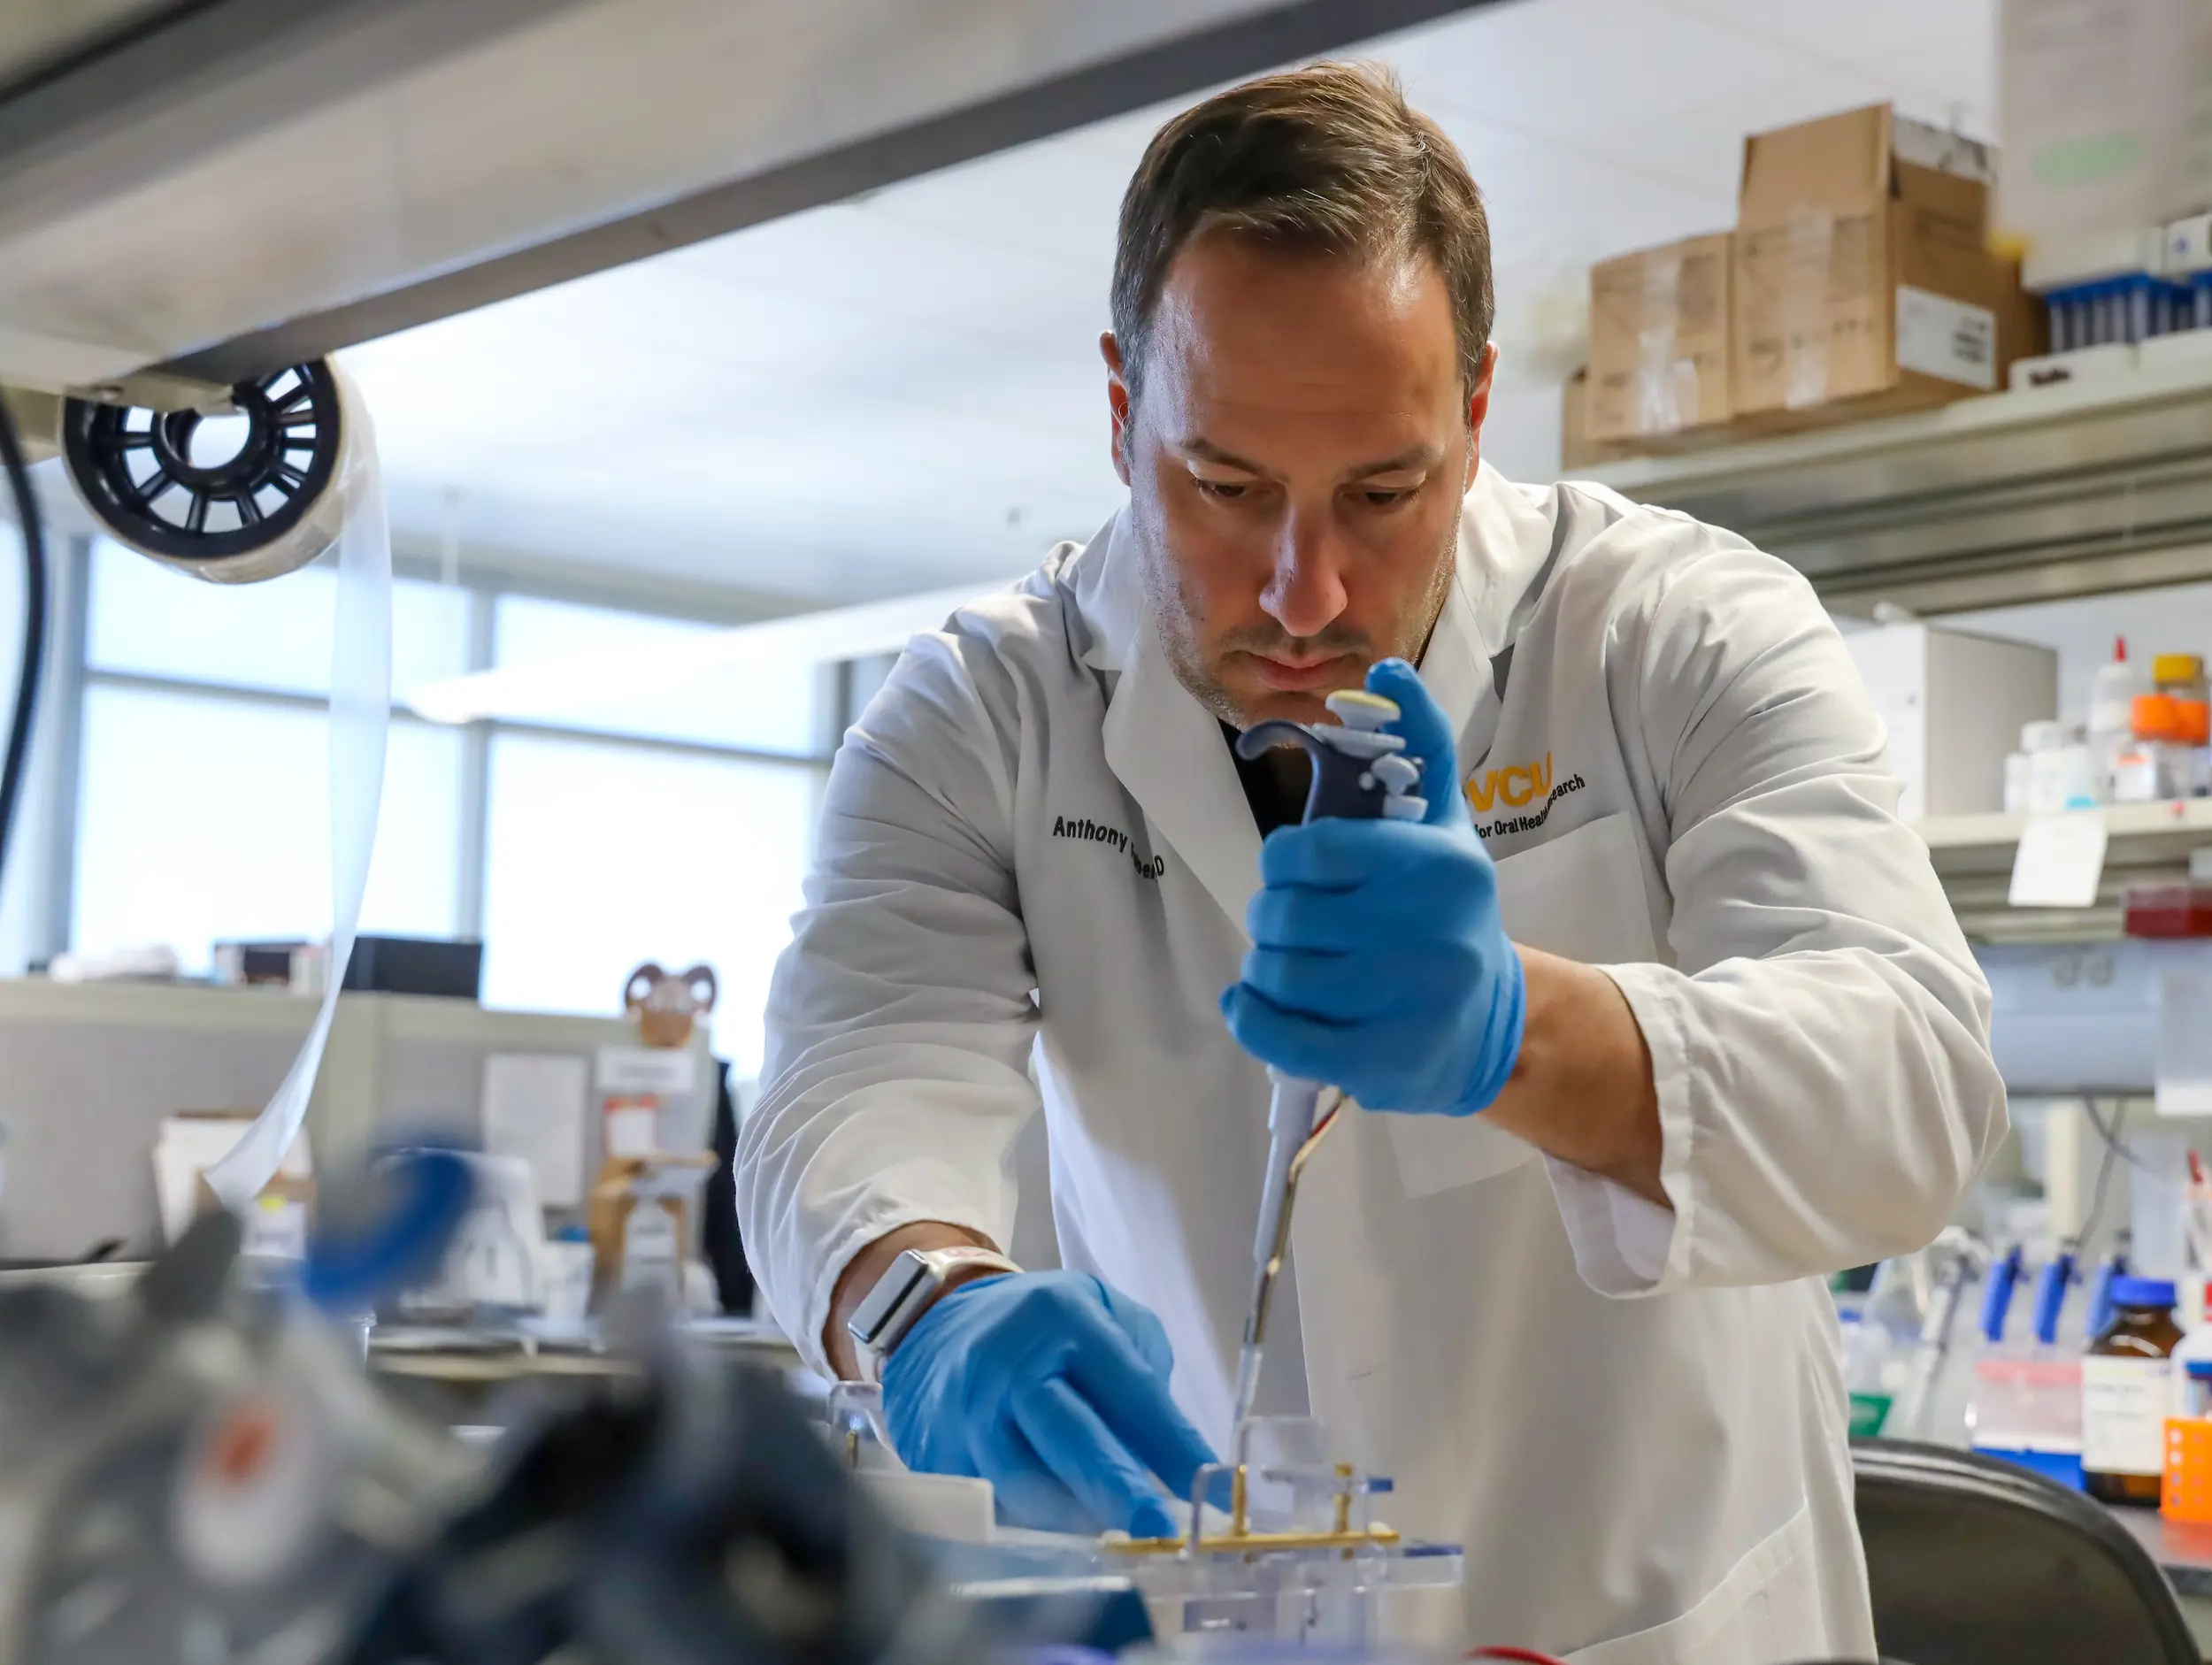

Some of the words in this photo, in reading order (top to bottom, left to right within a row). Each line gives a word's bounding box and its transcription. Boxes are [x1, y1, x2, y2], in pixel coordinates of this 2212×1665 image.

[1467, 749, 1553, 813] VCU
[1053, 816, 1128, 854] Anthony
[1494, 818, 1519, 836] Oral
